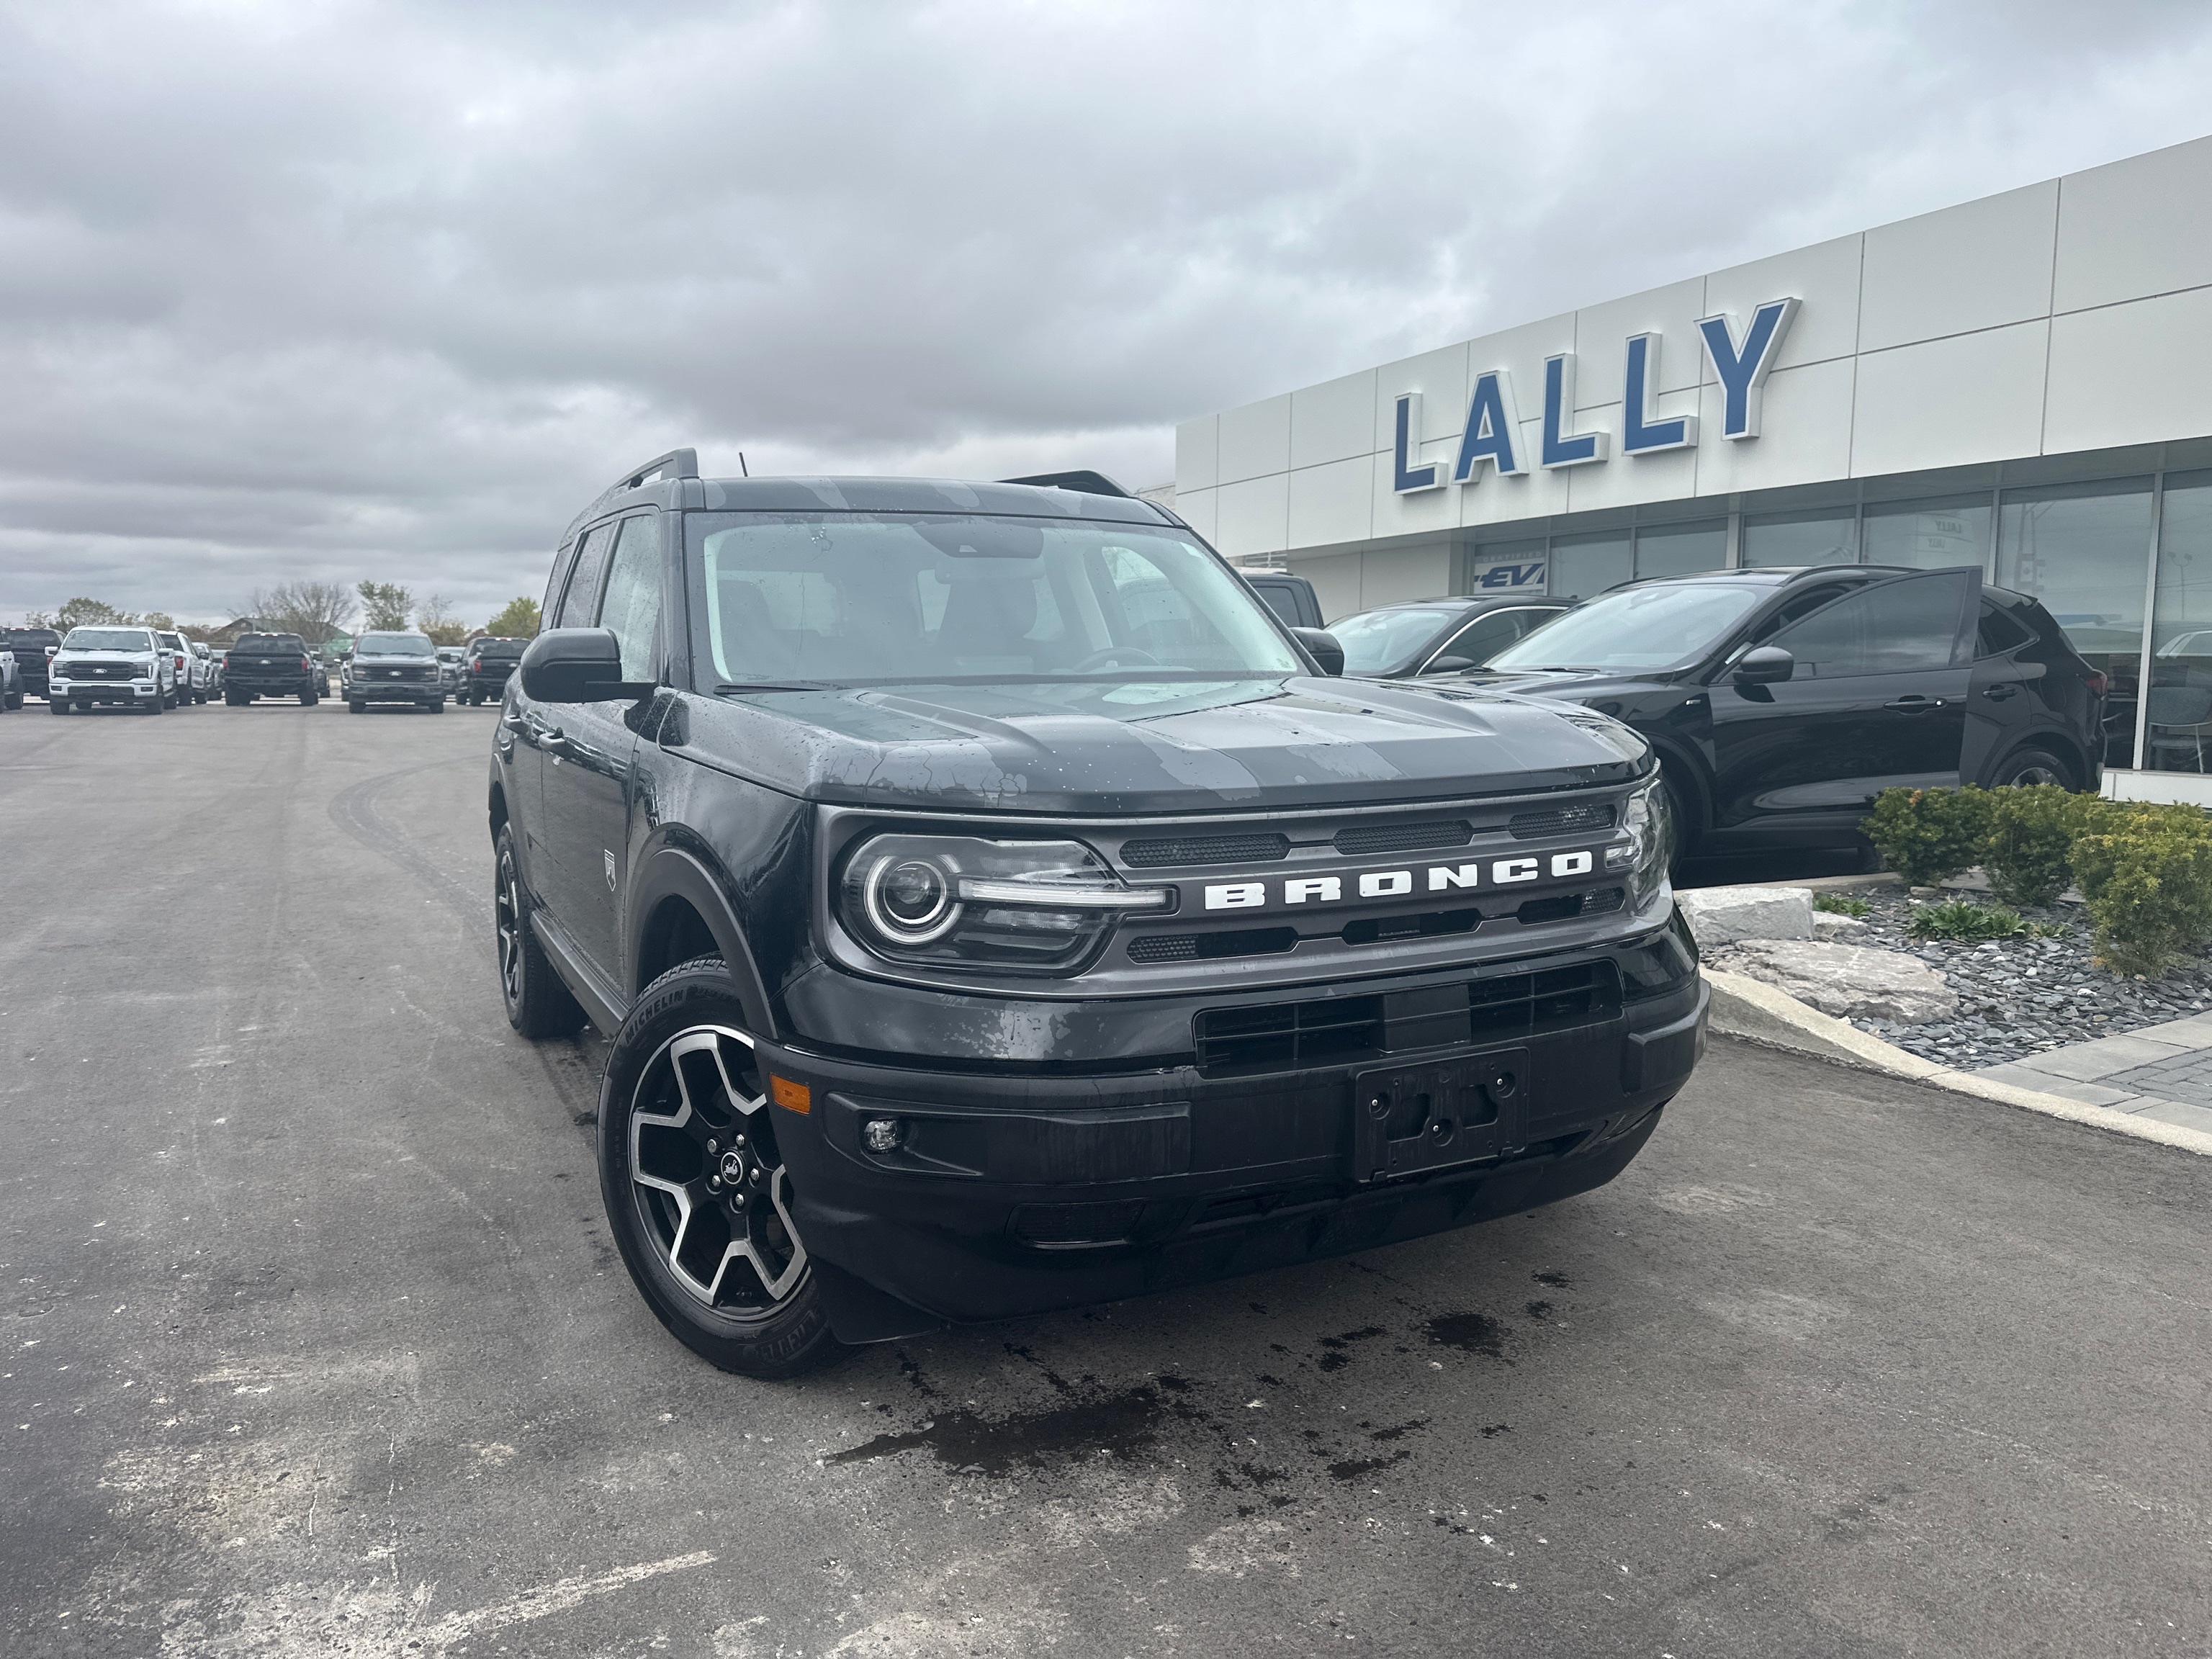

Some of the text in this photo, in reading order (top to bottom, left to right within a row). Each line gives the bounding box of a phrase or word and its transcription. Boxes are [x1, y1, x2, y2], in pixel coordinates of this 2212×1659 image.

[1393, 297, 1802, 495] LALLY
[1481, 563, 1545, 588] EV
[1483, 552, 1541, 562] CERTIFIED
[1205, 850, 1592, 910] BRONCO
[625, 989, 684, 1044] MICHELIN
